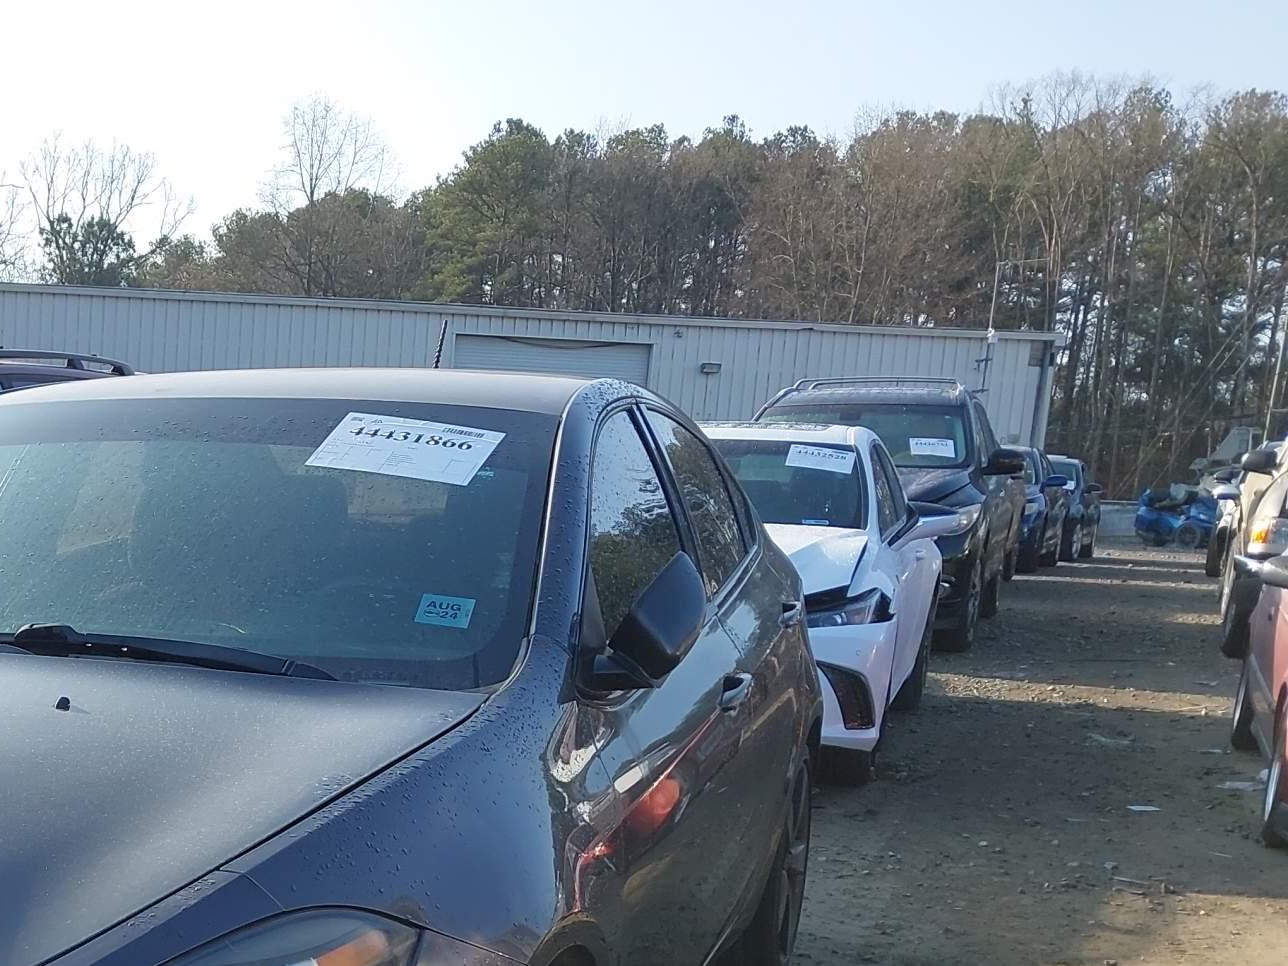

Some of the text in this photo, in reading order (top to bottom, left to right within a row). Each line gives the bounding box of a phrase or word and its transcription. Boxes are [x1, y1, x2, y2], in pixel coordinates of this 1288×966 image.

[349, 425, 474, 451] 44431866
[425, 600, 462, 612] AUG
[439, 610, 458, 621] 24
